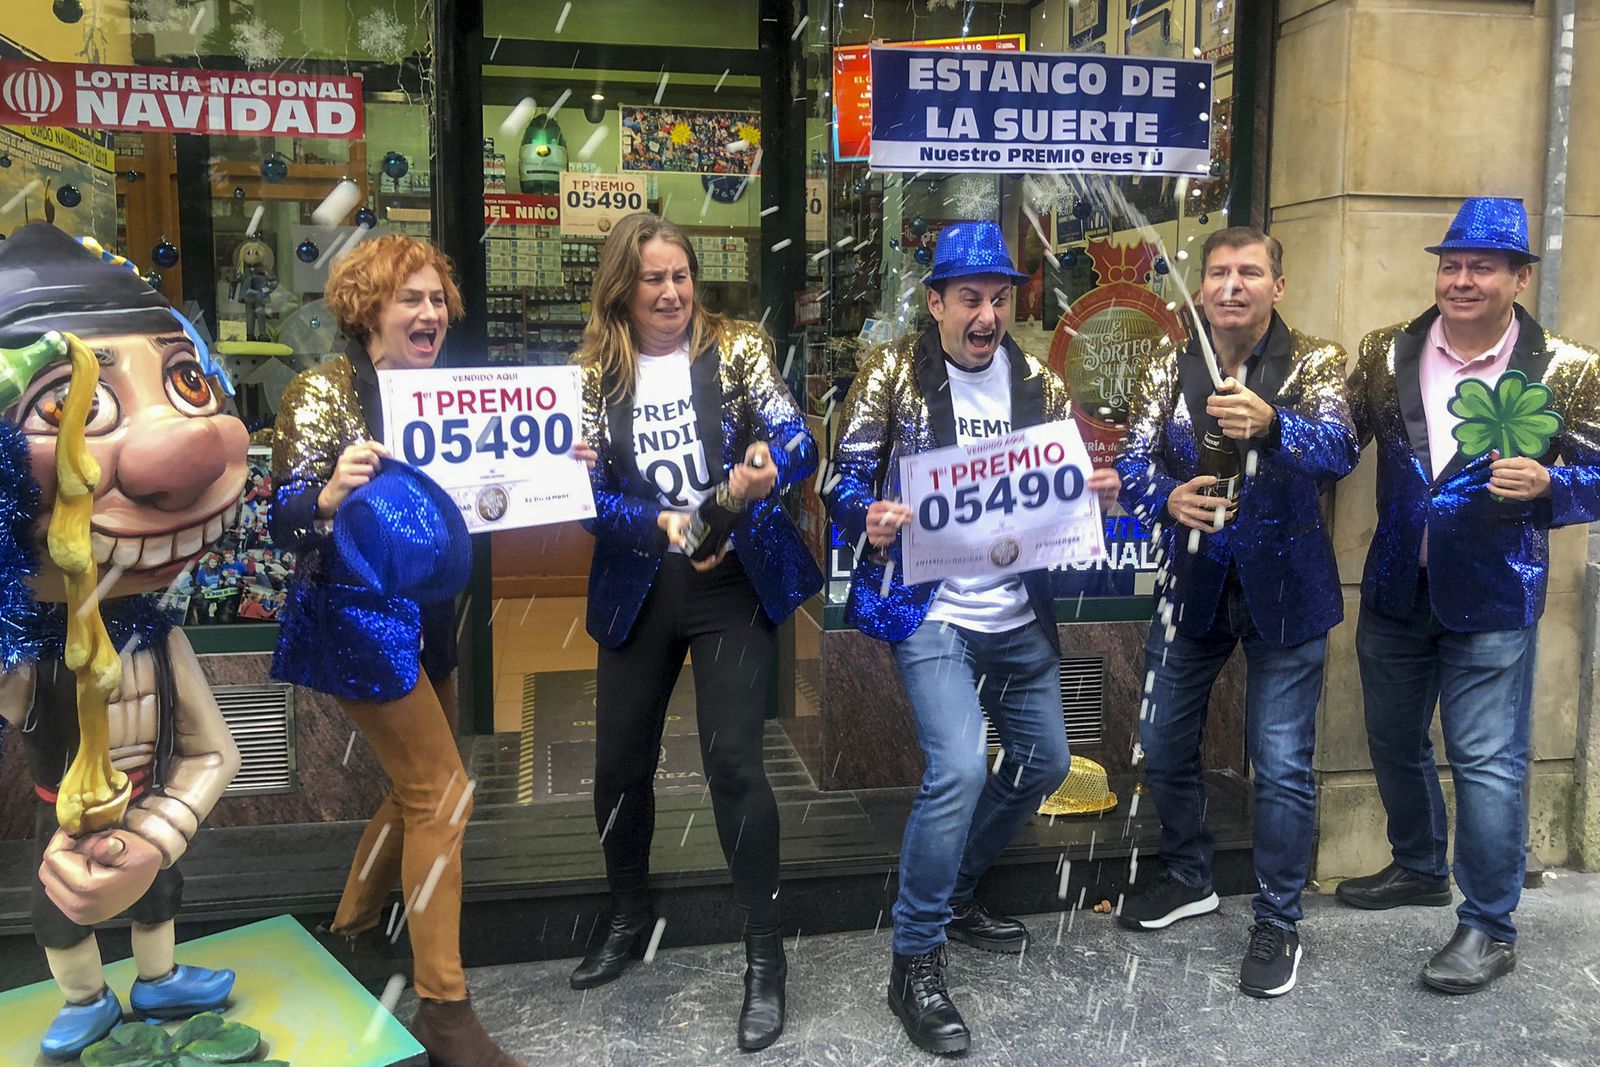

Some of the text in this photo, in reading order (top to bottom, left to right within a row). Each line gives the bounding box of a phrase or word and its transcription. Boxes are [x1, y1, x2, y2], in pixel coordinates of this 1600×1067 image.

[75, 69, 353, 99] LOTERÍA NACIONAL
[908, 57, 1176, 98] ESTANCO DE
[76, 90, 357, 135] NAVIDAD
[926, 106, 1158, 143] LA SUERTE
[920, 146, 1001, 162] Nuestro
[1008, 148, 1085, 164] PREMIO
[1091, 151, 1133, 164] eres
[567, 191, 642, 210] 05490
[582, 180, 635, 192] PREMIO
[515, 203, 558, 220] NIÑO
[452, 372, 518, 382] VENDIDO AQUÍ
[436, 386, 557, 416] PREMIO
[402, 412, 573, 467] 05490
[951, 441, 1065, 488] PREMIO
[918, 464, 1084, 531] 05490
